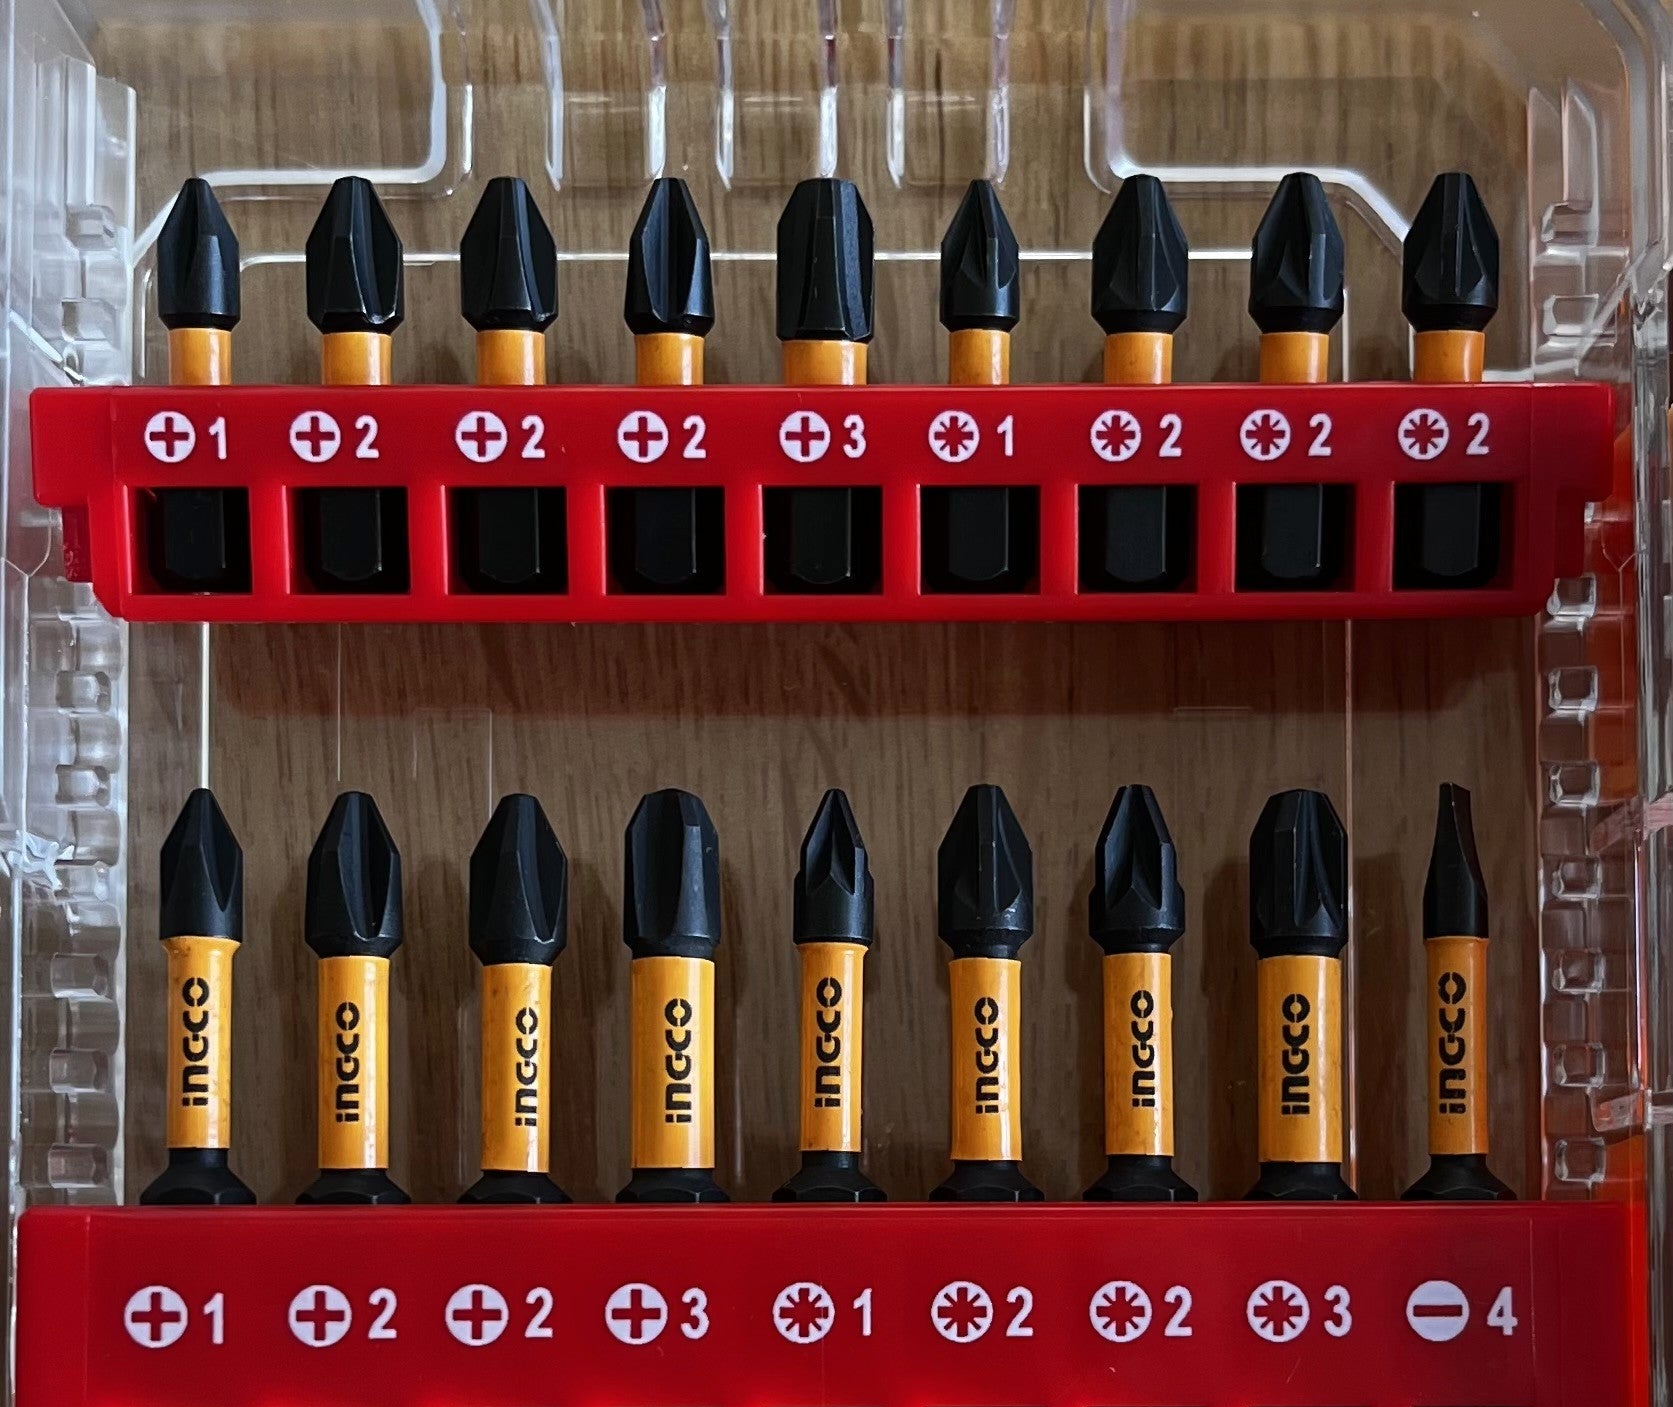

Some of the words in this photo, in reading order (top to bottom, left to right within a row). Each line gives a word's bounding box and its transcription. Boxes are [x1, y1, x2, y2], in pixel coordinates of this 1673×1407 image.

[208, 416, 227, 460] 1
[355, 414, 380, 459] 2
[521, 414, 546, 459] 2
[682, 415, 707, 459] 2
[843, 414, 867, 459] 3
[996, 414, 1014, 457] 1
[1159, 413, 1182, 458] 2
[1308, 413, 1332, 456] 2
[1466, 412, 1490, 455] 2
[203, 1292, 224, 1345] 1
[368, 1287, 397, 1340] 2
[524, 1286, 553, 1338] 2
[680, 1287, 710, 1340] 3
[853, 1287, 873, 1337] 1
[1006, 1286, 1034, 1337] 2
[1164, 1285, 1193, 1337] 2
[1324, 1285, 1353, 1337] 3
[1487, 1286, 1518, 1336] 4
